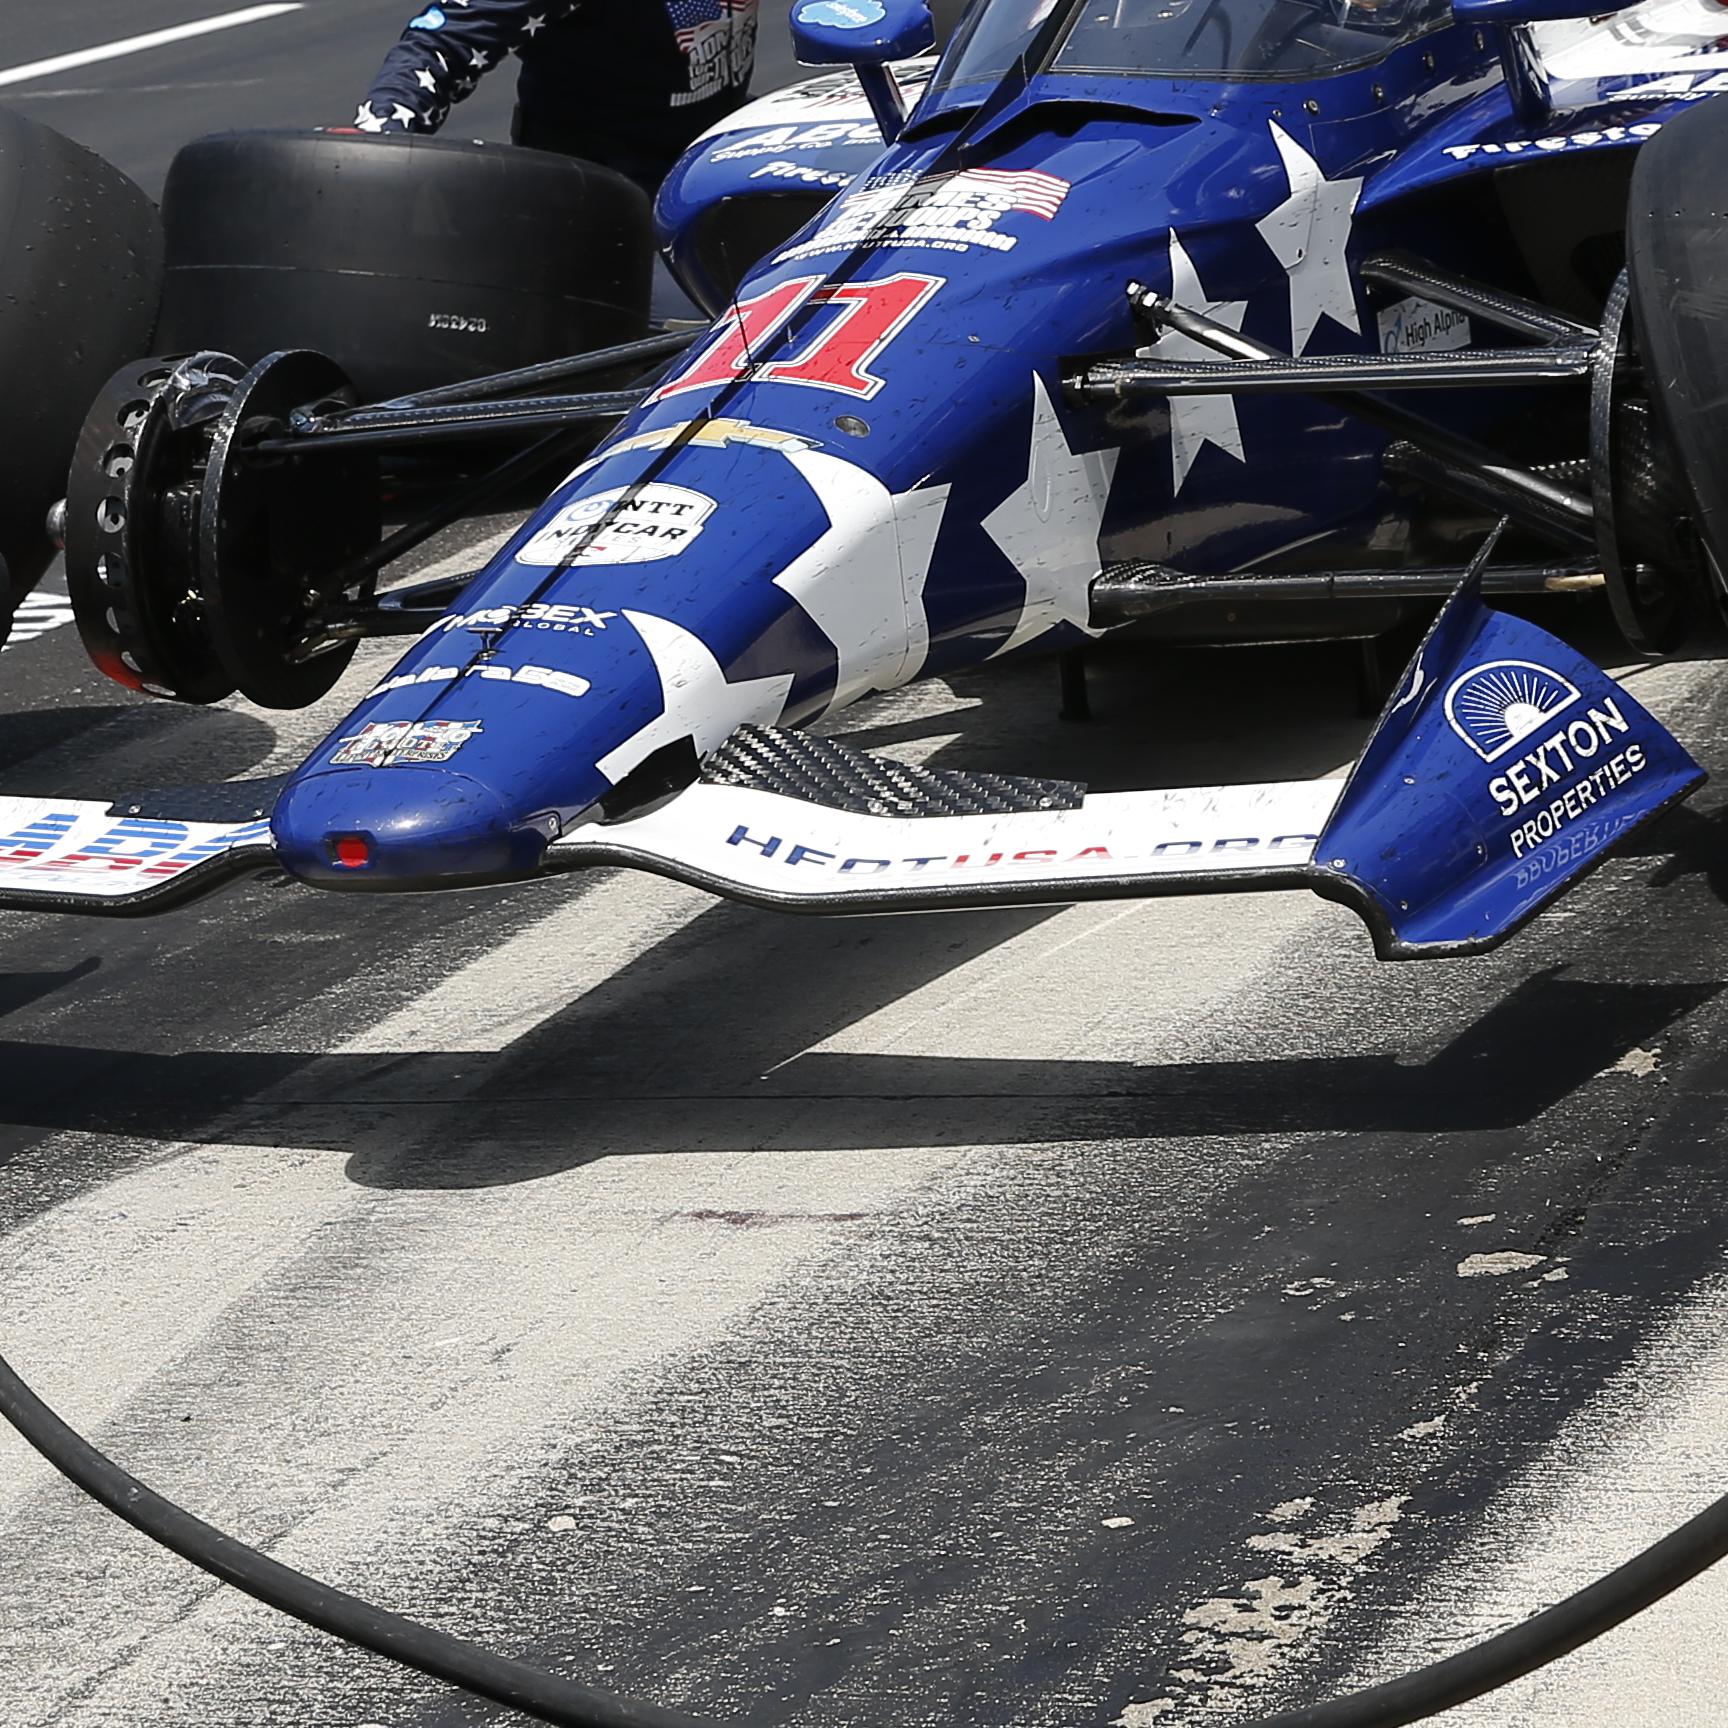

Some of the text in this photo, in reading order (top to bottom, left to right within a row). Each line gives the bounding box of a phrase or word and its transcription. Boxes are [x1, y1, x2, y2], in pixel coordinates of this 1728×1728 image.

[643, 271, 948, 409] 11
[1404, 316, 1432, 347] High
[619, 498, 695, 517] NTT
[1487, 696, 1631, 817] SEXTON
[1510, 743, 1648, 859] PROPERTIES
